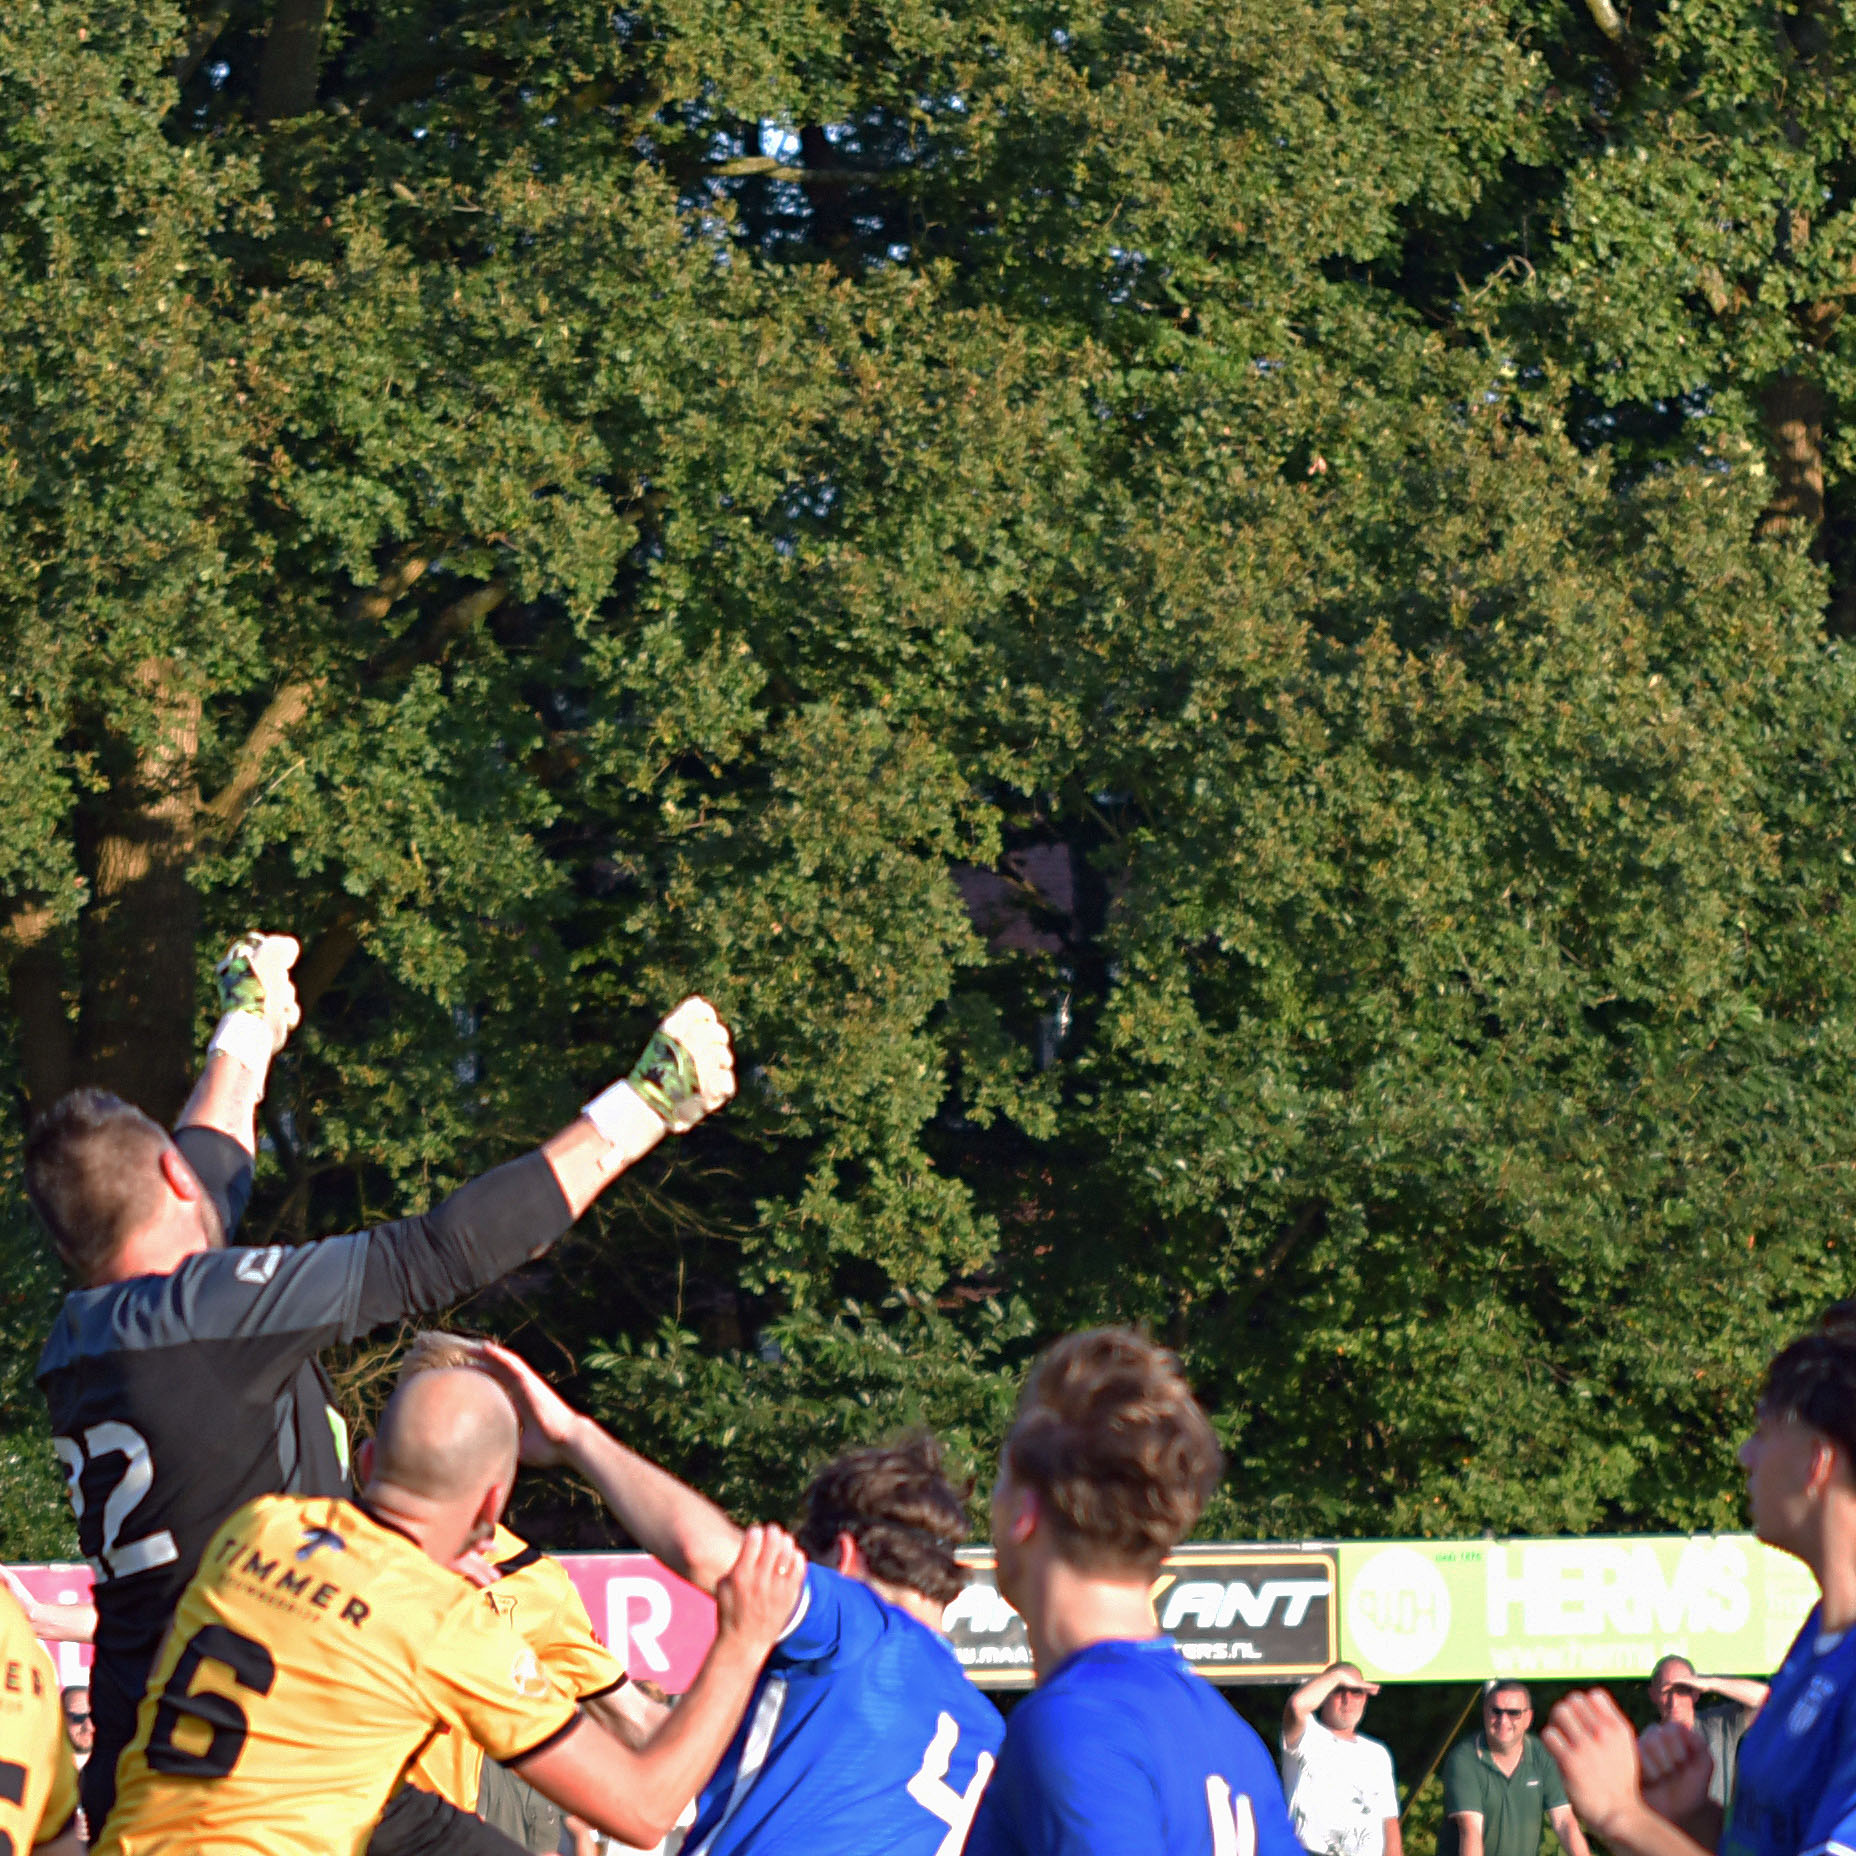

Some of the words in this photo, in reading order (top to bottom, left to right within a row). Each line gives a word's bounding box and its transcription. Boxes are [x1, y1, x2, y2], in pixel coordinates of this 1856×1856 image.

[216, 1539, 371, 1630] TIMMER
[1486, 1546, 1751, 1636] HERMS
[147, 1624, 275, 1780] 6
